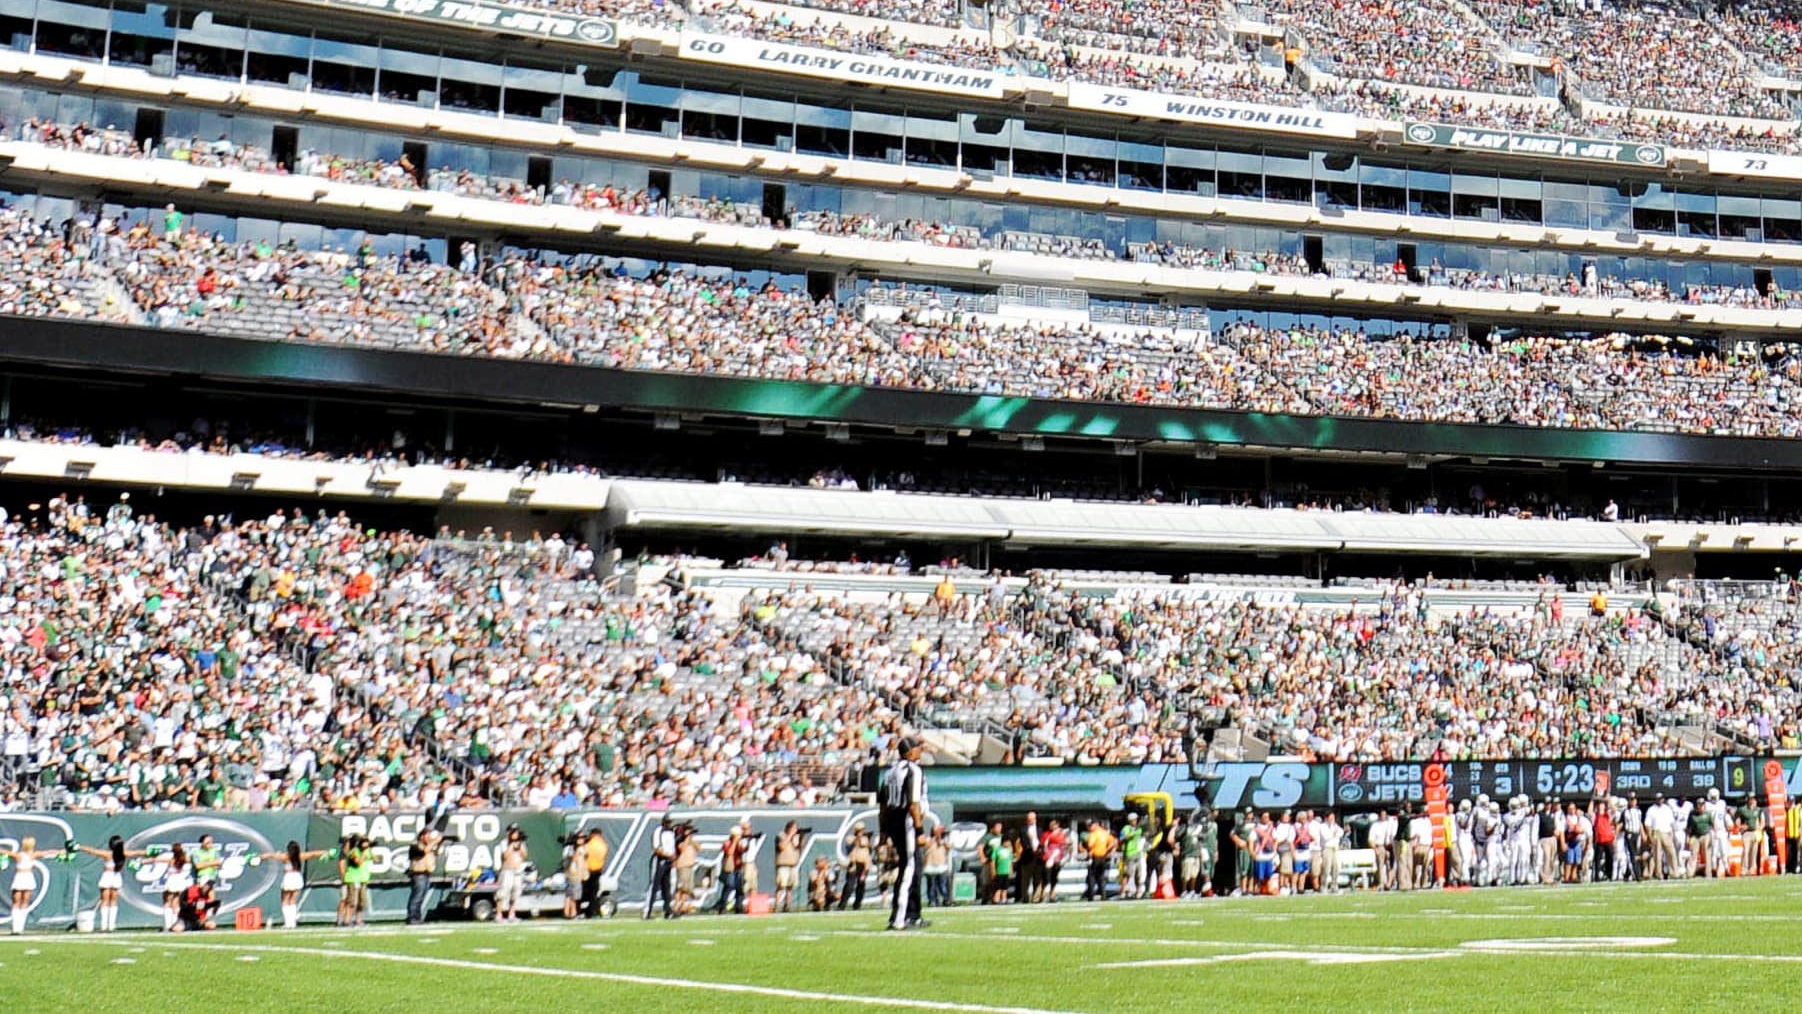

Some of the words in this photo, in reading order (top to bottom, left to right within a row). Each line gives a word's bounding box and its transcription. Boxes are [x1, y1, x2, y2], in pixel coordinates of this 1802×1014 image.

[439, 1, 502, 24] THE
[500, 12, 577, 37] JETS
[689, 39, 726, 55] 60
[758, 48, 842, 70] LARRY
[848, 61, 993, 89] GRANTHAM
[1101, 93, 1128, 108] 75
[1166, 101, 1273, 124] WINSTON
[1275, 113, 1325, 129] HILL
[1449, 130, 1510, 149] PLAY
[1509, 136, 1561, 154] LIKE
[1559, 139, 1577, 156] A
[1579, 143, 1623, 159] JET
[1743, 159, 1768, 171] 73
[1367, 765, 1421, 781] BUCS
[1536, 764, 1594, 794] 5:23
[1616, 775, 1651, 788] 3RD
[1663, 774, 1674, 787] 4
[1732, 766, 1744, 786] 9
[1368, 784, 1423, 801] JETS
[1495, 776, 1512, 795] 3
[341, 815, 424, 842] BAC
[450, 815, 500, 841] TO
